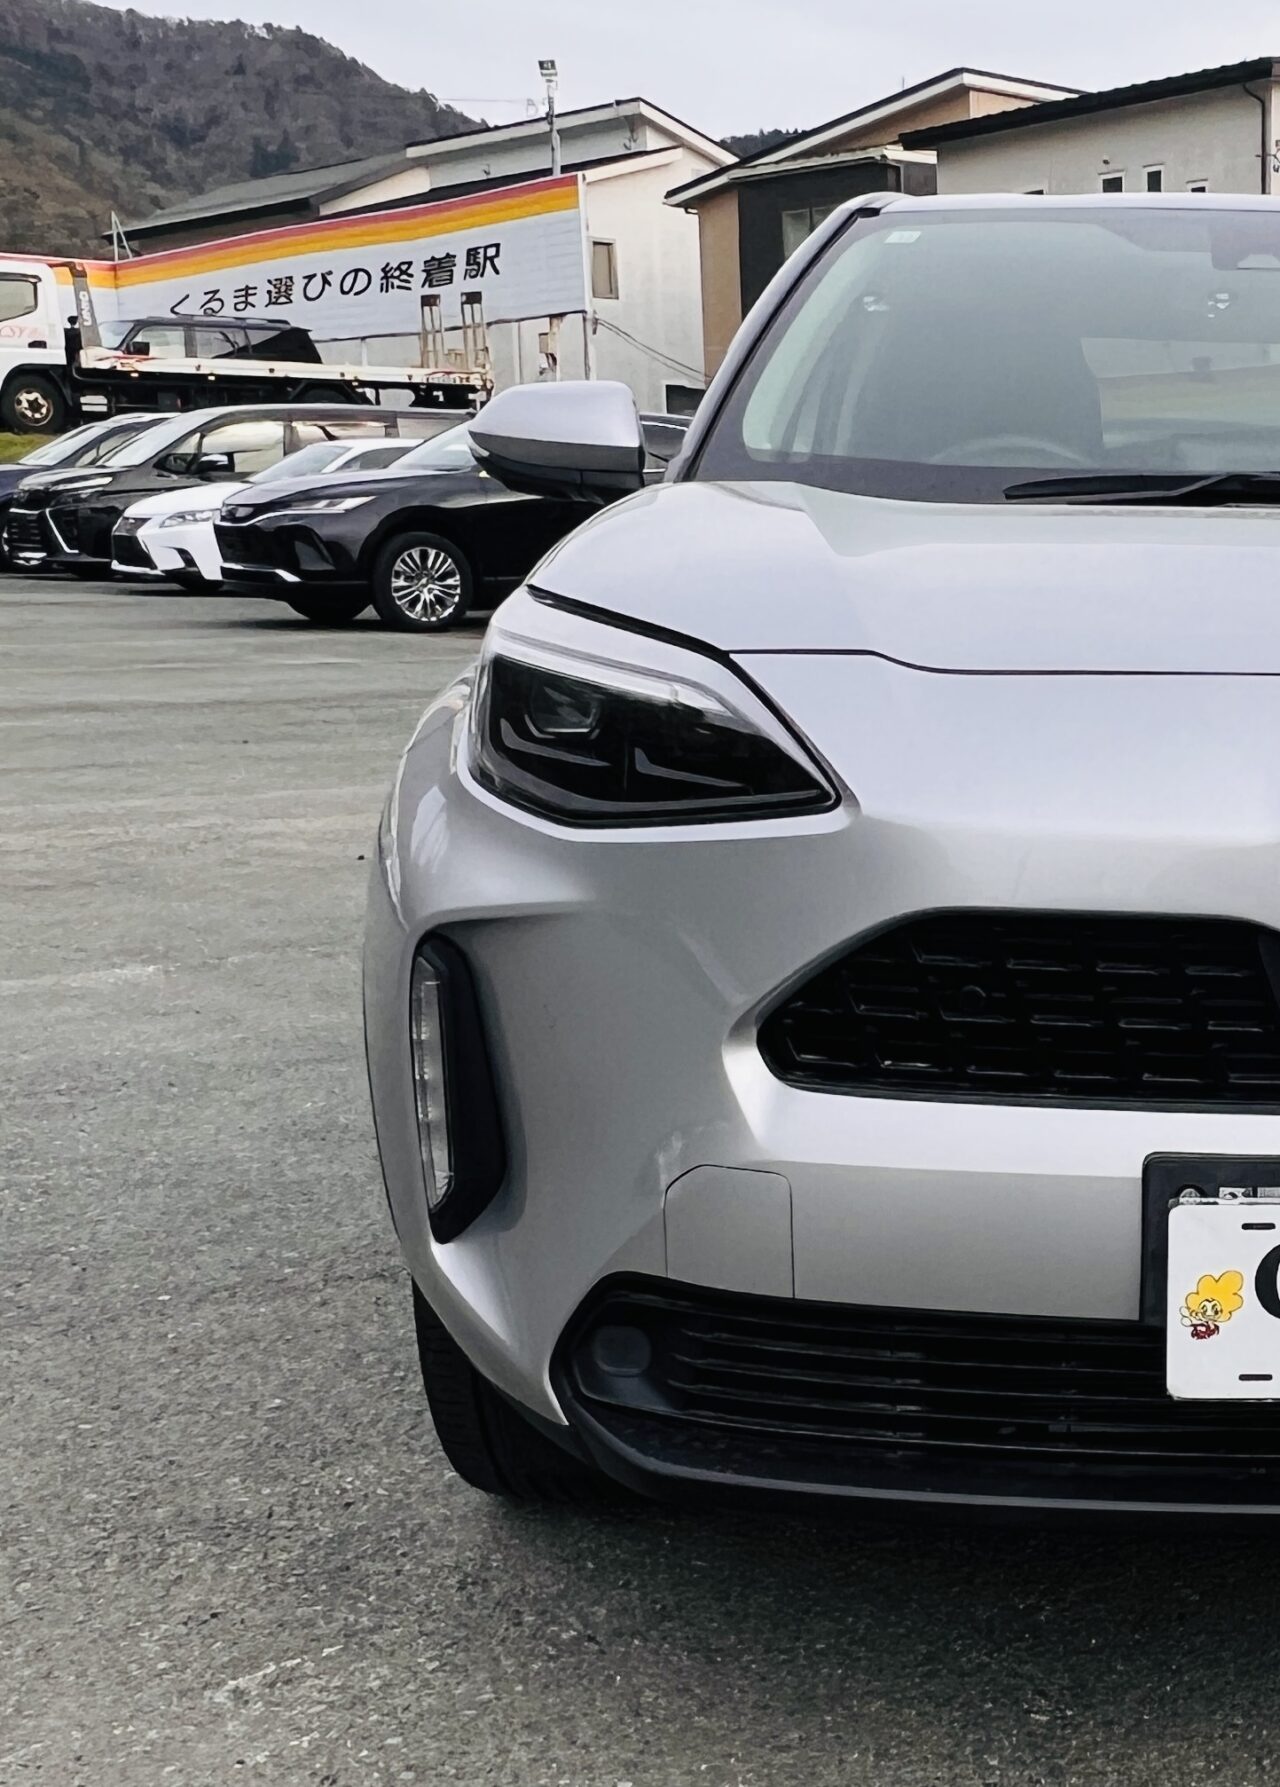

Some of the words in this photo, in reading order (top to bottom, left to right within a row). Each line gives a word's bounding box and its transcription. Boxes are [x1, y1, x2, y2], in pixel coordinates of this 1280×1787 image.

[170, 243, 501, 316] くるま選びの終着駅
